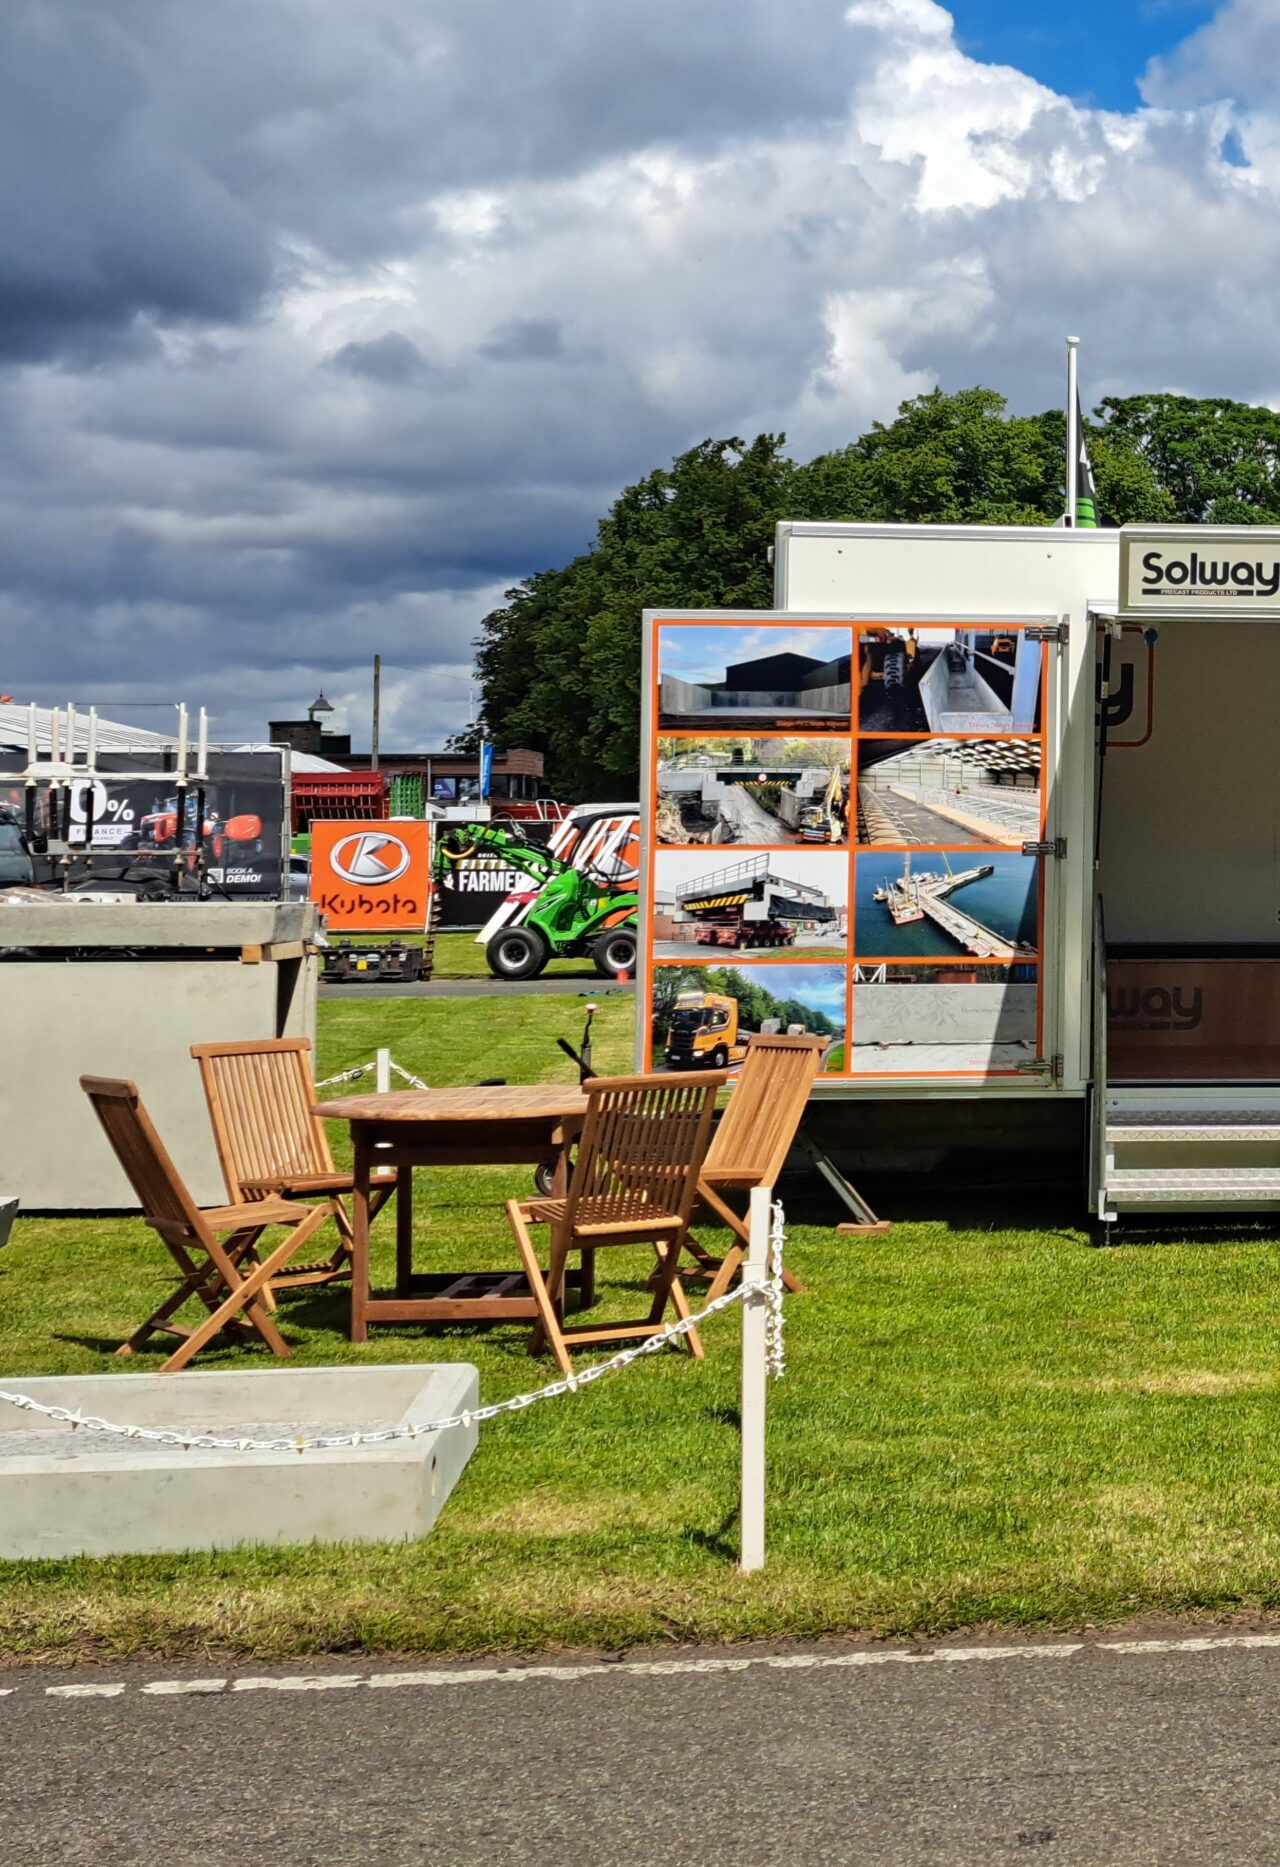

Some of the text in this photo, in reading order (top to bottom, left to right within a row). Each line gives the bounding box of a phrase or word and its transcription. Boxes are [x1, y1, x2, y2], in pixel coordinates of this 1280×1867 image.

[1142, 552, 1280, 596] Solway
[226, 874, 261, 883] DEMO!
[320, 894, 416, 914] Kubota
[1107, 987, 1203, 1031] way
